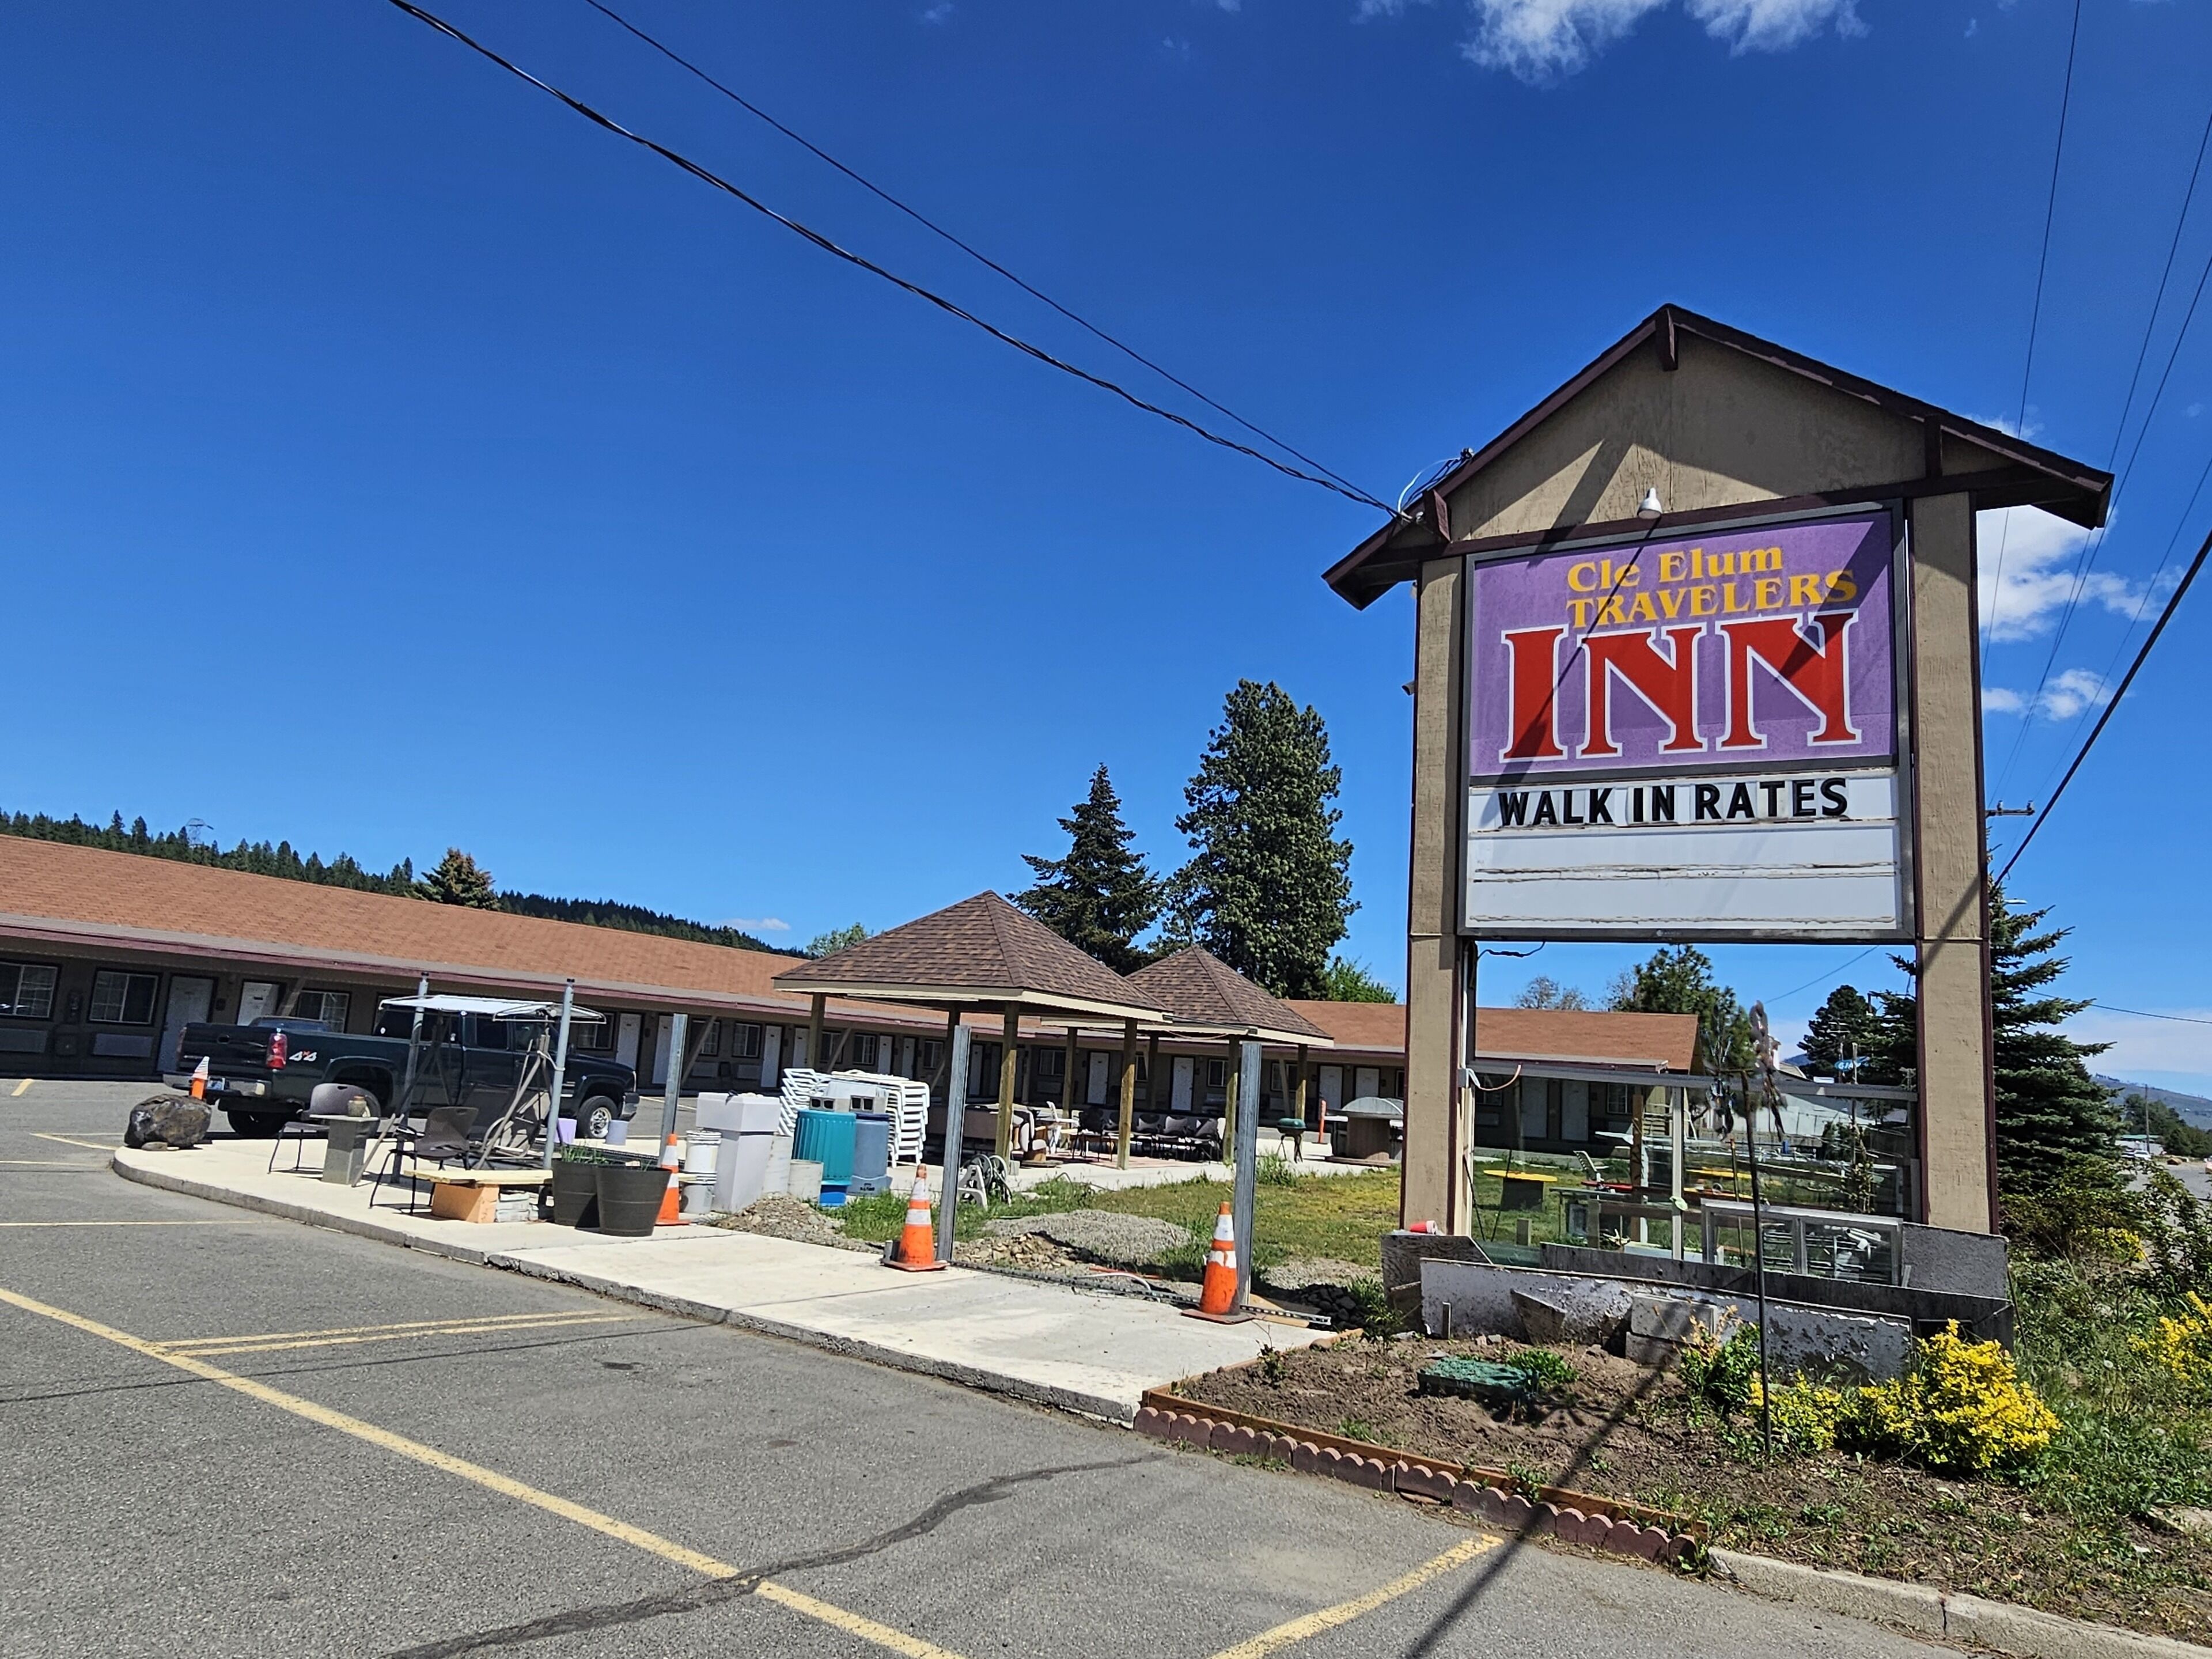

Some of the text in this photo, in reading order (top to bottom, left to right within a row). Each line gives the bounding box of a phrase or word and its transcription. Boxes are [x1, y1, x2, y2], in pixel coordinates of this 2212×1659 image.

[1567, 546, 1783, 592] Cle Elum
[1566, 569, 1858, 628] TRAVELERS
[1499, 611, 1862, 763] INN
[1498, 778, 1848, 826] WALK IN RATES
